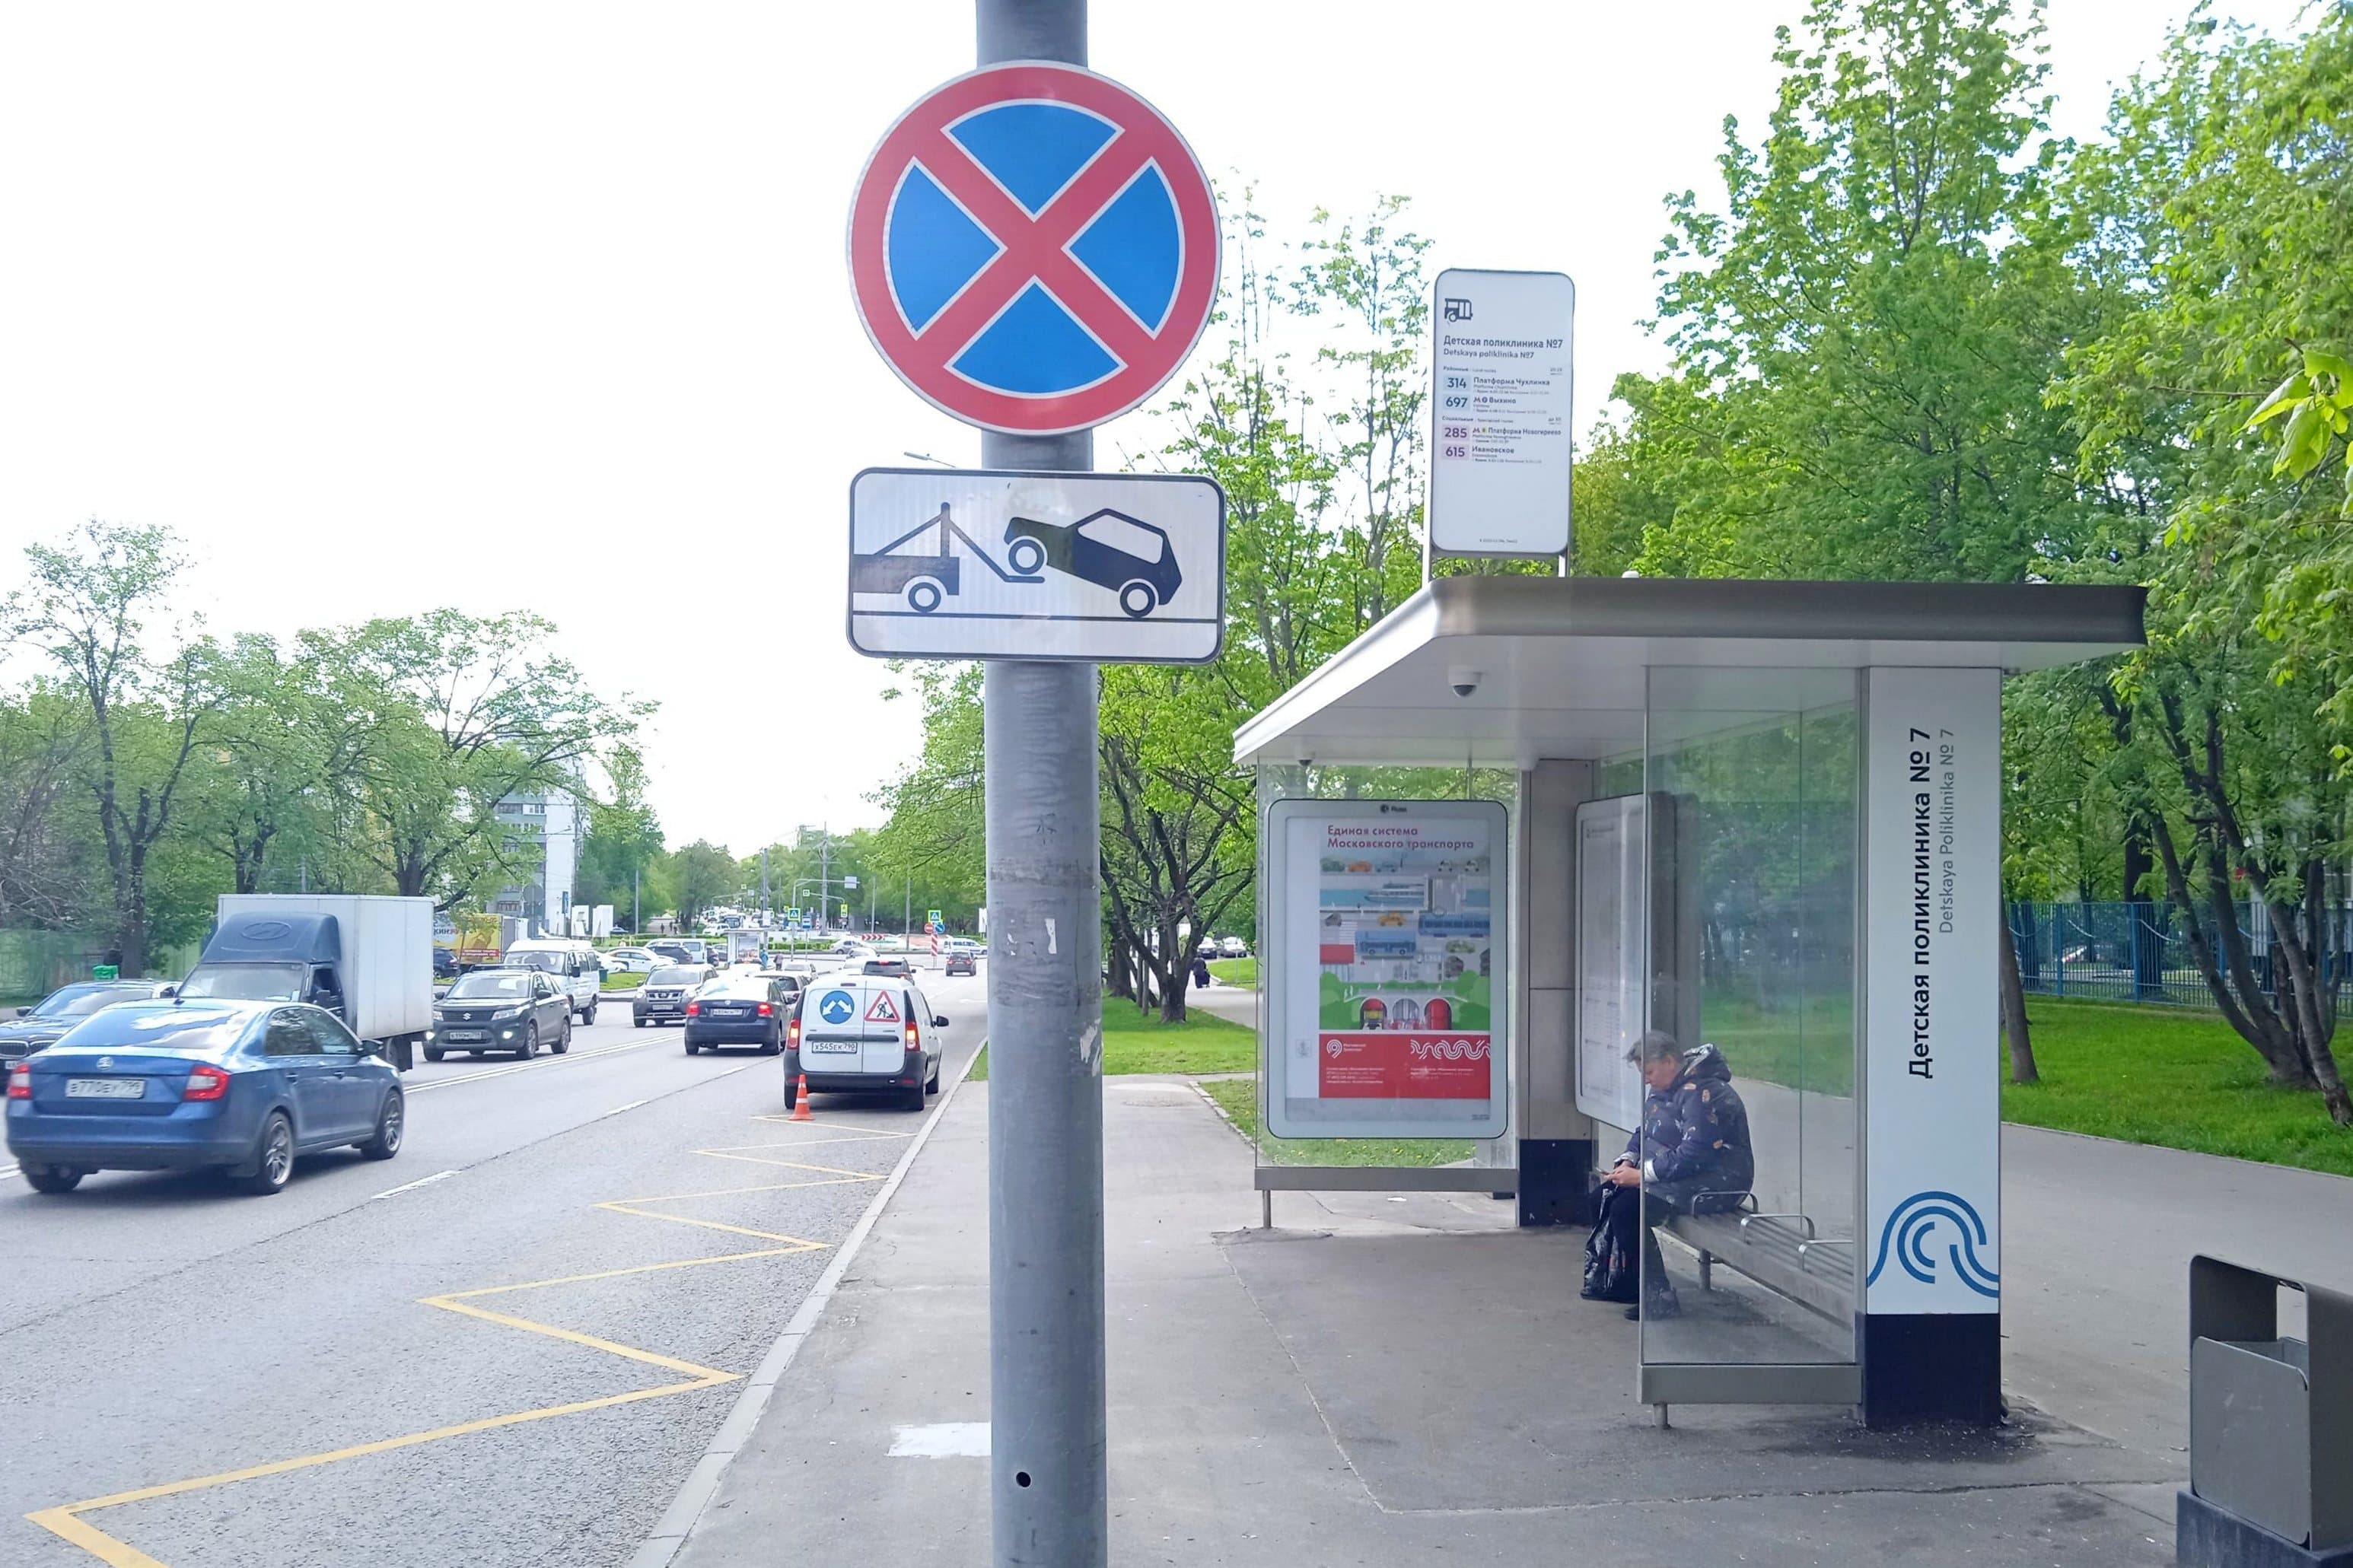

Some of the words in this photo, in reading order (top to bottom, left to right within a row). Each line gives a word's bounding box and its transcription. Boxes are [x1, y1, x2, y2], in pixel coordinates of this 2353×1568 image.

[1443, 335, 1481, 346] Детская
[1483, 339, 1544, 348] поликлиника
[1546, 339, 1563, 348] №7
[1443, 348, 1477, 358] Detskaya
[1479, 350, 1518, 358] poliklinika
[1447, 377, 1466, 389] 314
[1473, 377, 1514, 385] Платформа
[1446, 396, 1468, 408] 697
[1444, 427, 1467, 438] 285
[1446, 447, 1465, 457] 615
[1910, 727, 1931, 743] 7
[1941, 729, 1954, 738] 7
[1940, 744, 1954, 765] №
[1910, 751, 1931, 783] №
[1939, 771, 1954, 854] Poliklinika
[1328, 825, 1369, 836] Единая
[1328, 838, 1404, 848] Московского
[1407, 841, 1474, 851] транспорта
[1914, 791, 1930, 965] поликлиника
[1939, 860, 1957, 933] Detskaya
[1909, 975, 1933, 1079] Детская
